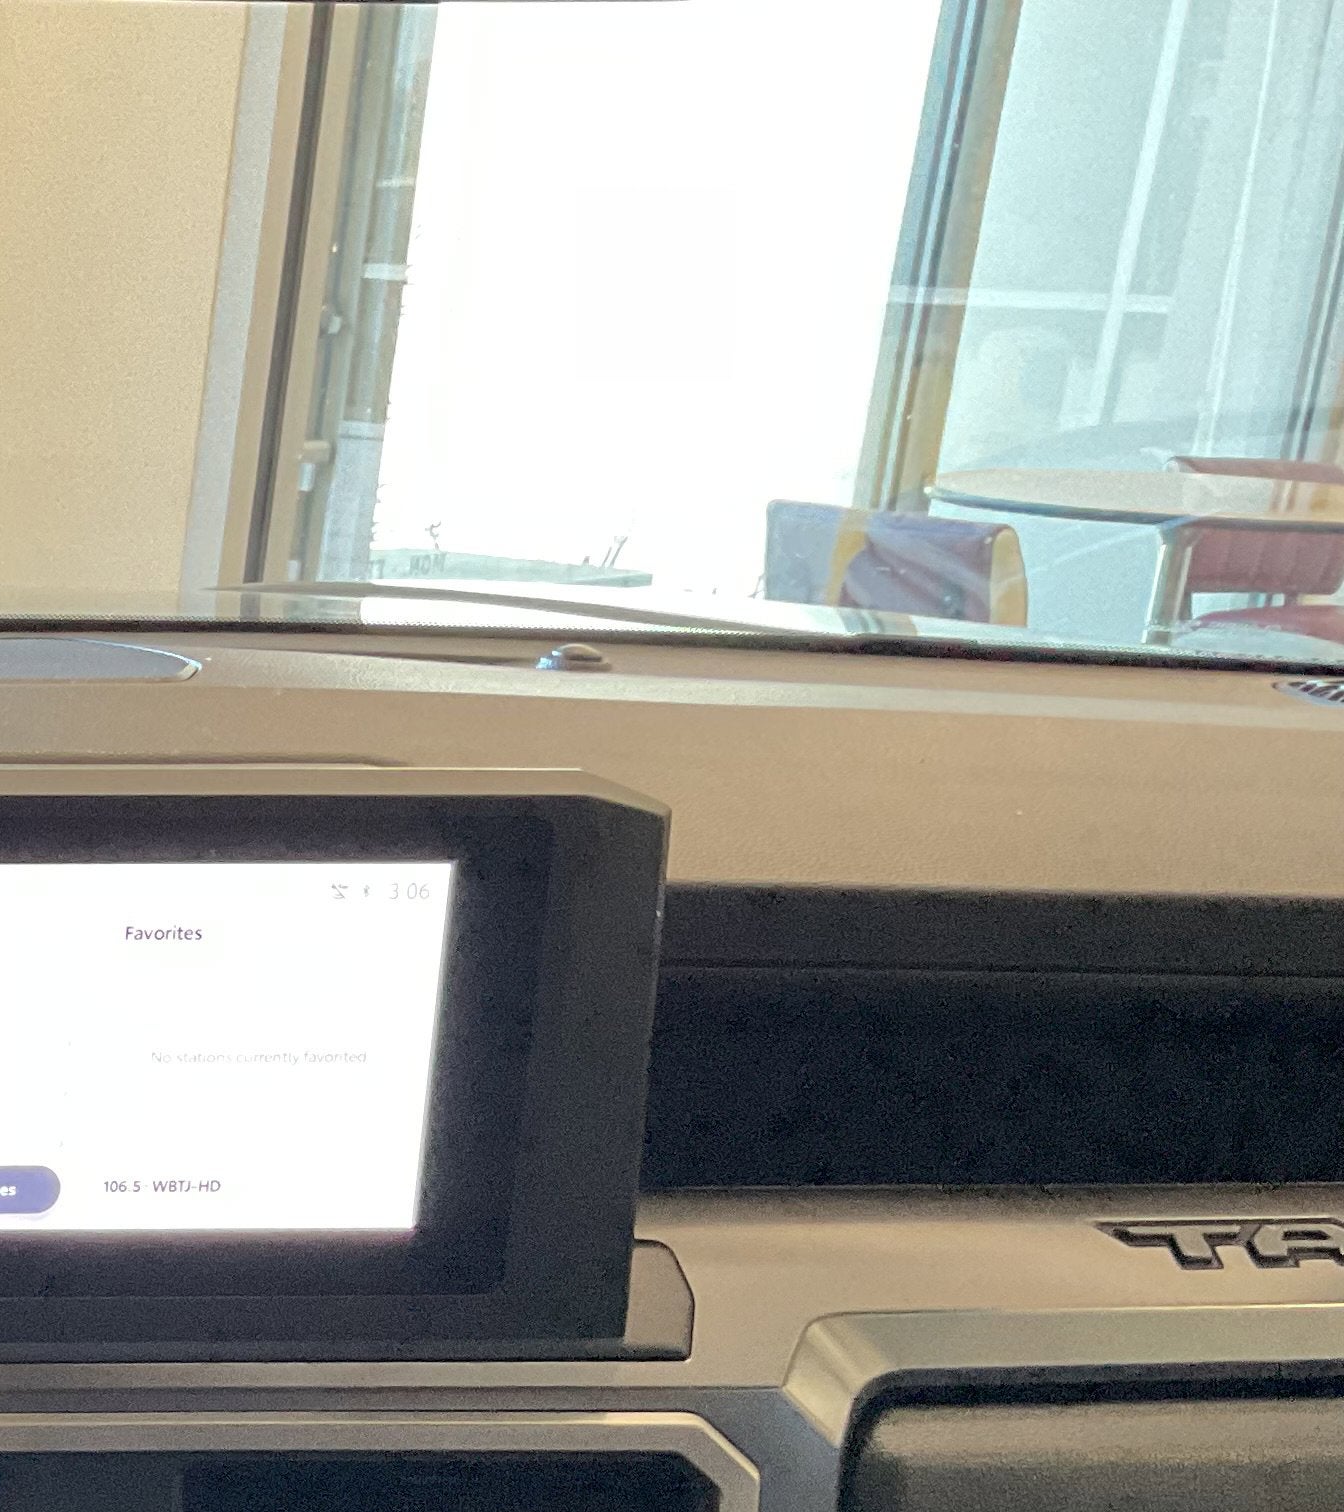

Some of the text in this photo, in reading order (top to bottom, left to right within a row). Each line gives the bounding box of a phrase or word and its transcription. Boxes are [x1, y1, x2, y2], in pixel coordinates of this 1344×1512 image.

[389, 882, 431, 900] 306
[125, 925, 203, 942] Favorites
[104, 1180, 221, 1194] 106.5 WBTJ-HD
